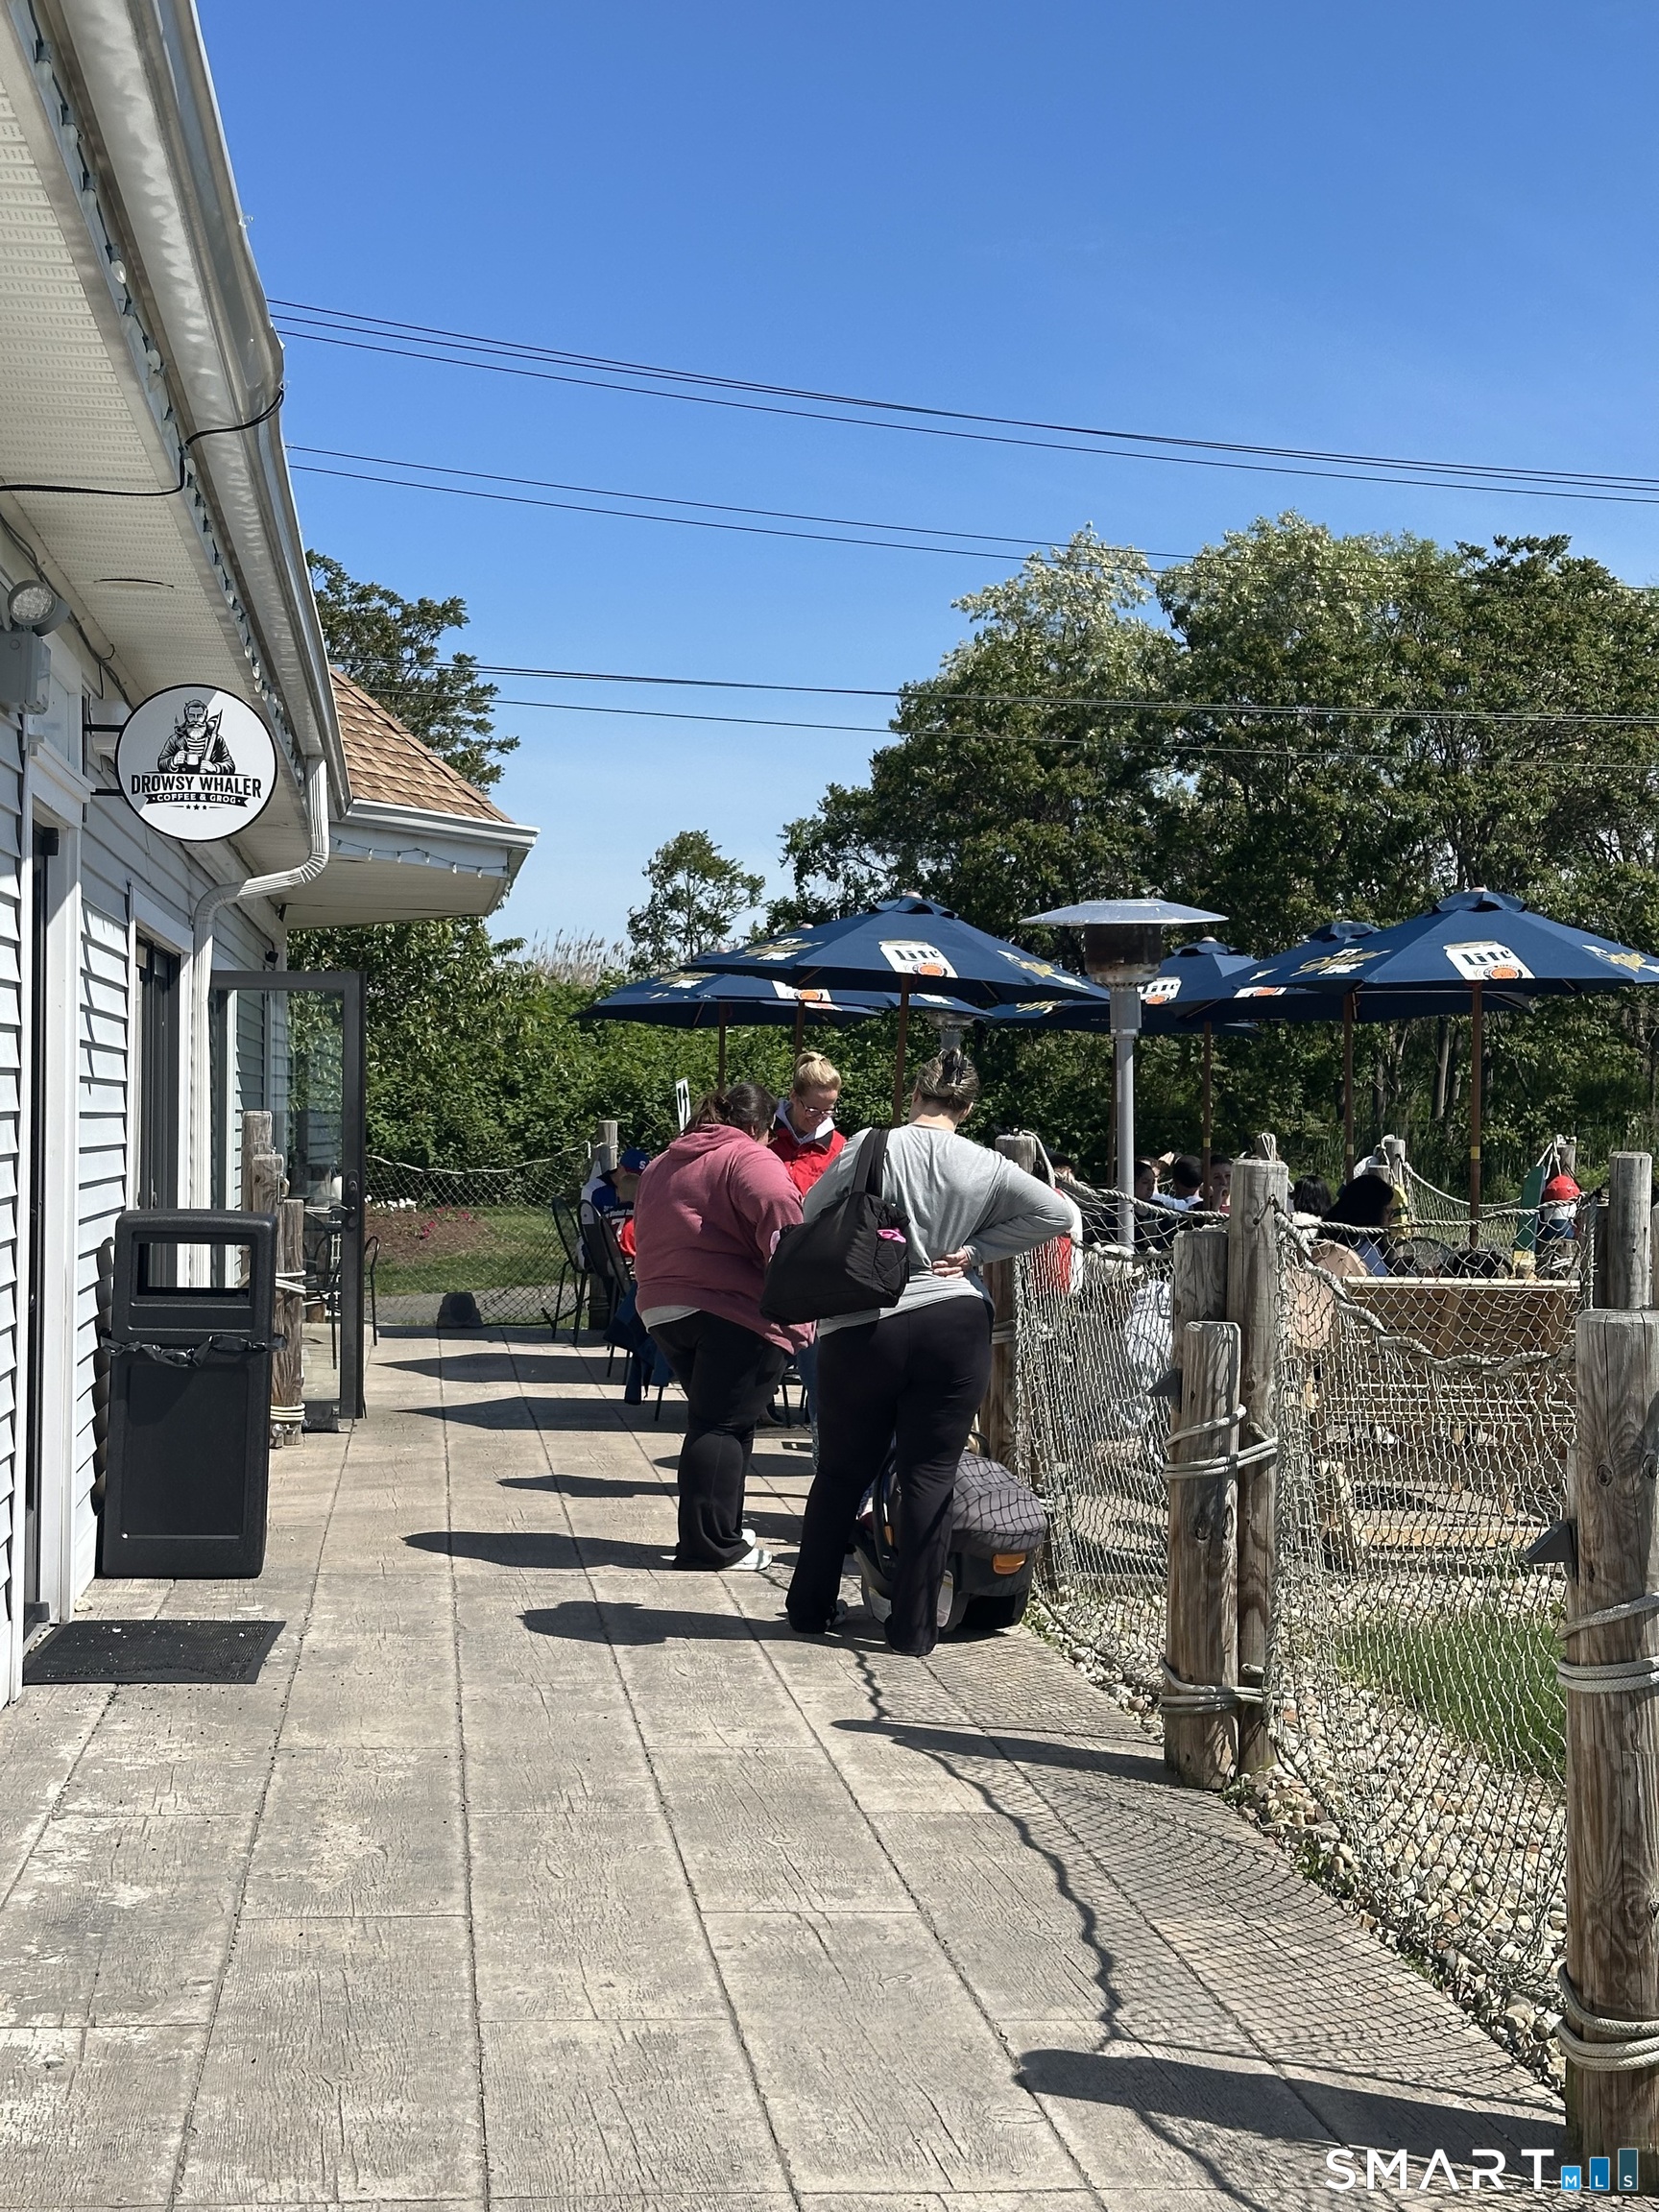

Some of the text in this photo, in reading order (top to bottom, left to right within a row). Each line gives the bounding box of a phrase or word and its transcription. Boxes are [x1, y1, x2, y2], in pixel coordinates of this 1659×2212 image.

[131, 774, 262, 799] DROWSY WHALER
[156, 793, 236, 804] COFFEE & GROG
